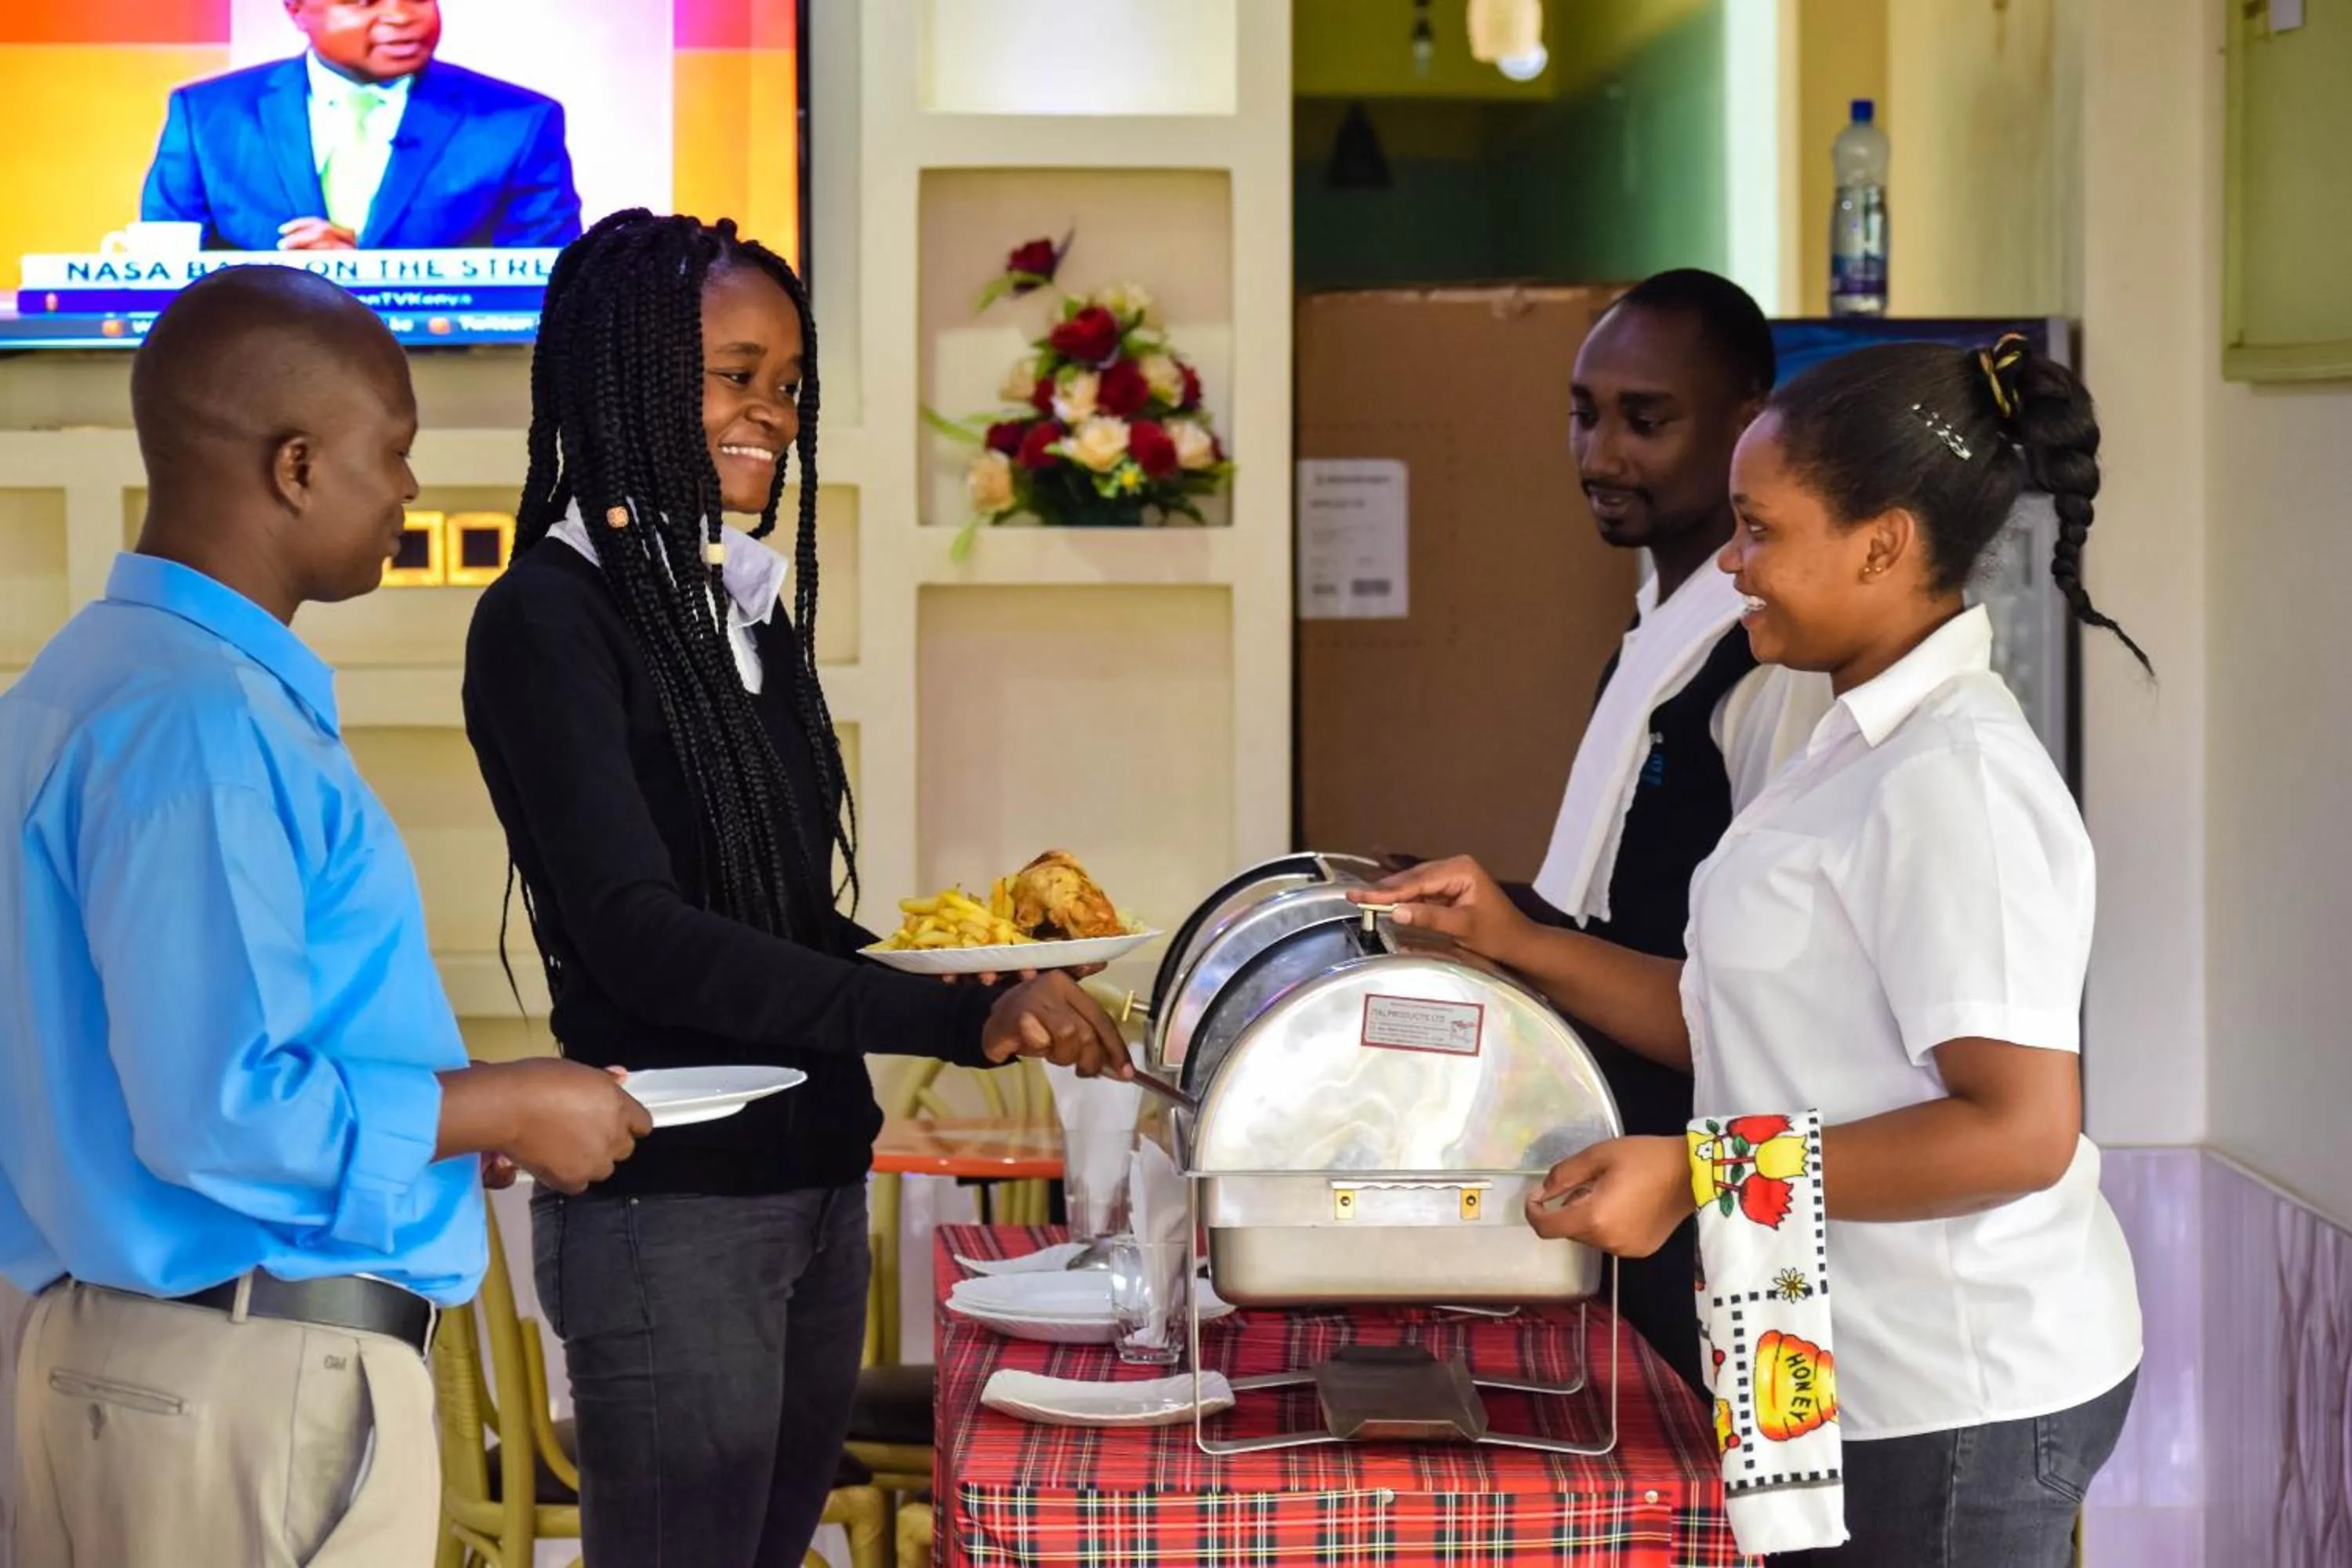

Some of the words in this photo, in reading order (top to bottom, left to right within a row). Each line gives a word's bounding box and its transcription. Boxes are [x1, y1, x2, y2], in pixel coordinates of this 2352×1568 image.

[67, 261, 171, 281] NASA
[306, 260, 358, 278] ON
[380, 260, 445, 278] THE
[462, 259, 552, 277] STRE
[1784, 1352, 1813, 1424] HONEY
